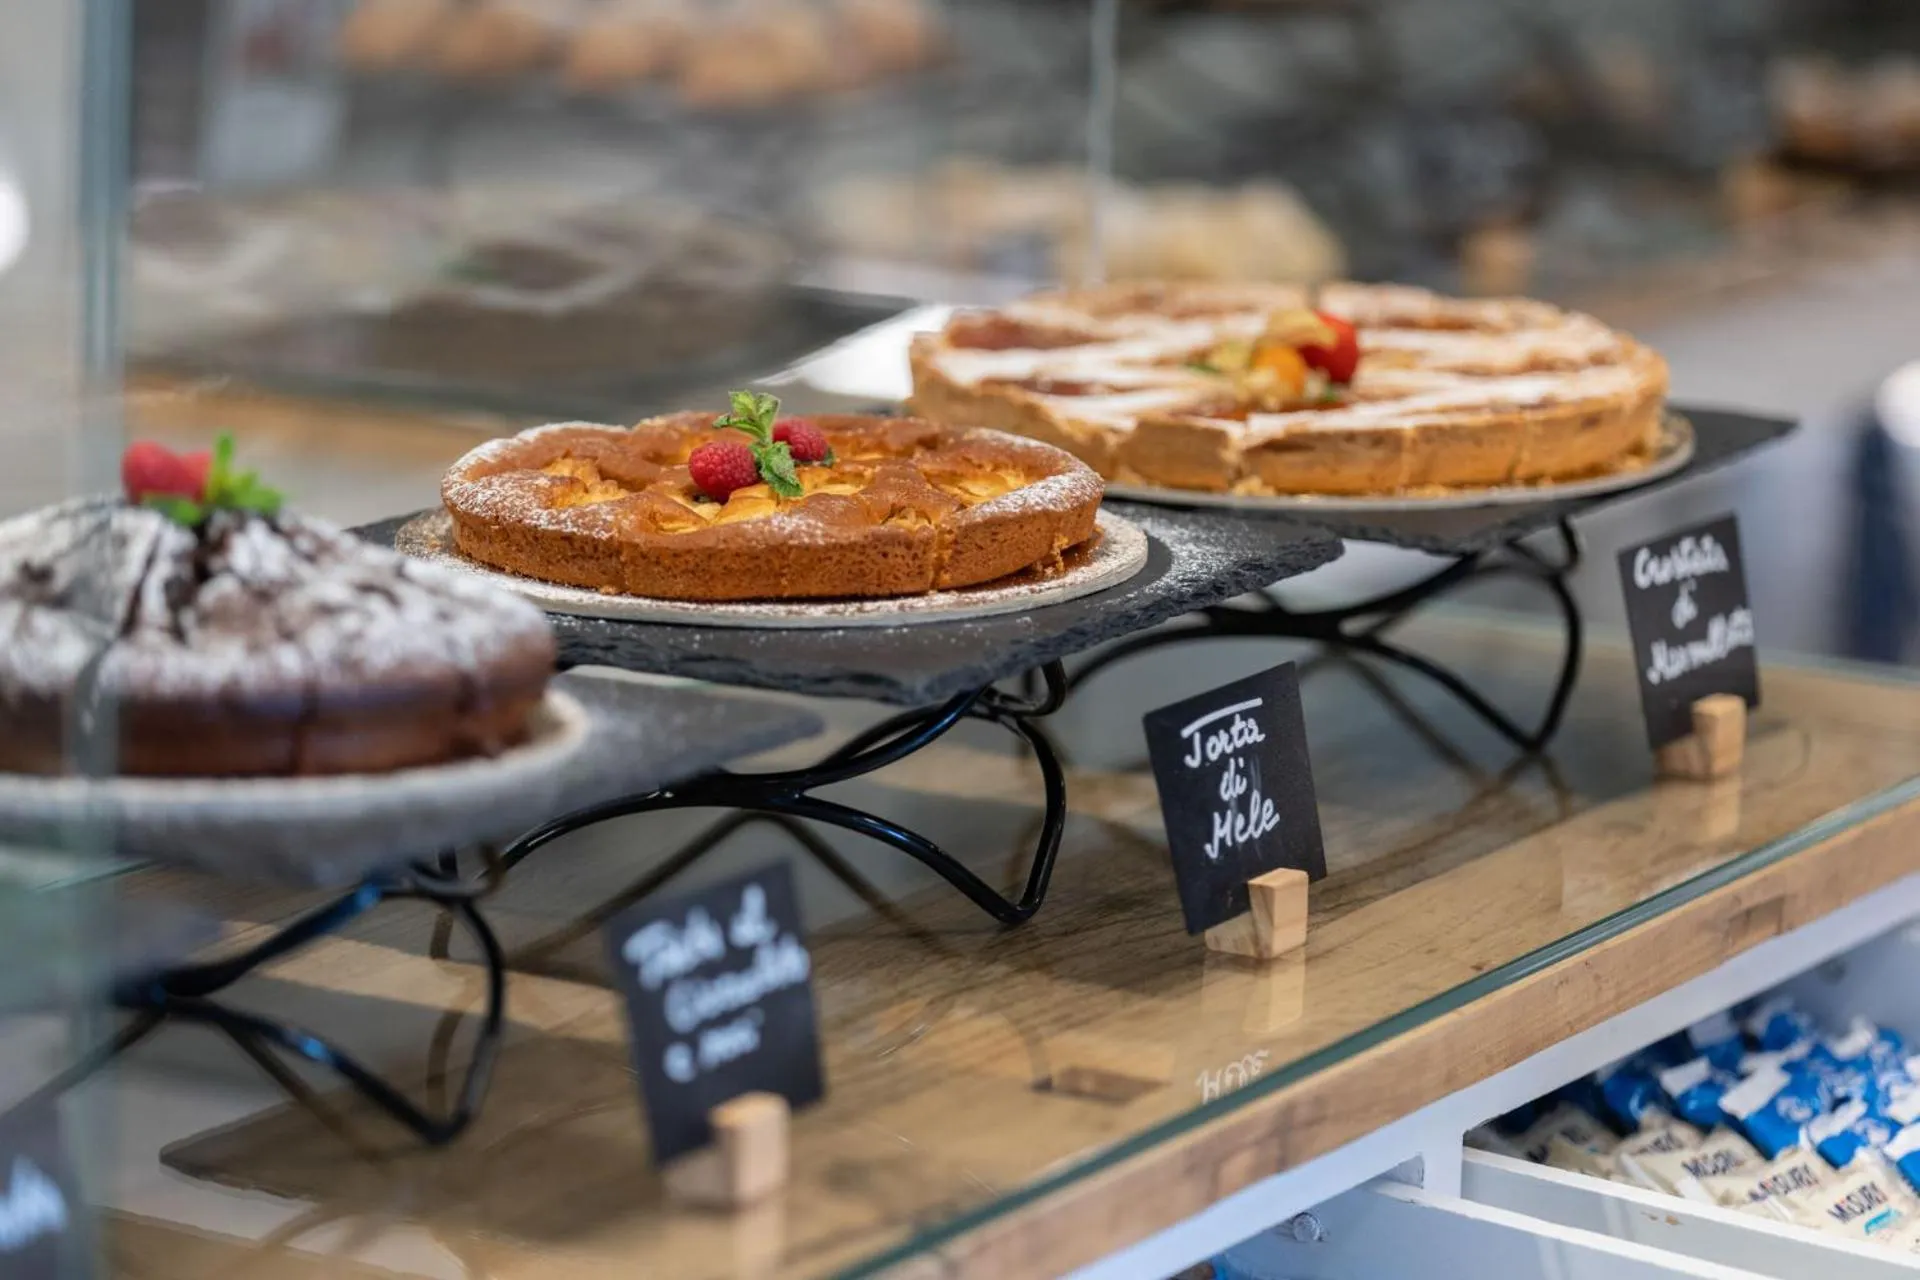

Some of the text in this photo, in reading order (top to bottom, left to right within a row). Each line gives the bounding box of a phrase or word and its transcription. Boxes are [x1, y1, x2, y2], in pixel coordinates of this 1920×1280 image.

[1181, 697, 1265, 769] Torta
[1219, 757, 1248, 802] di
[1203, 790, 1281, 860] Mele
